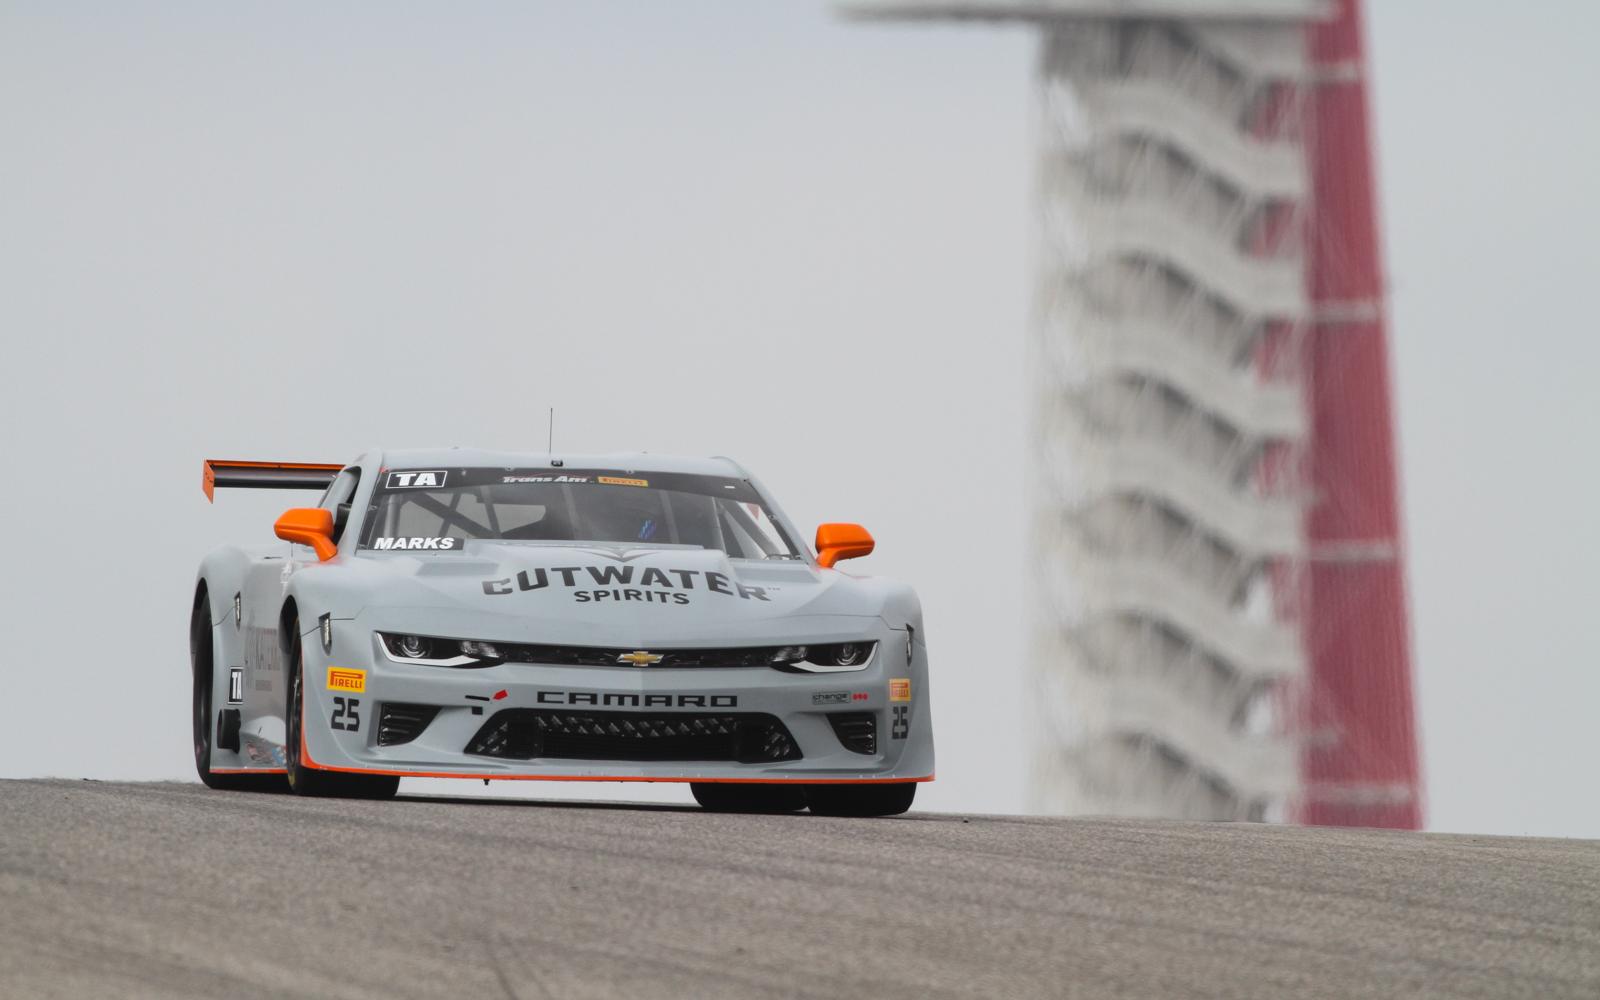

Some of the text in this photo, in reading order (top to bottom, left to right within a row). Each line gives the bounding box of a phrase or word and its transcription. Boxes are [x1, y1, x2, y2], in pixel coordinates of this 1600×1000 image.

[396, 472, 437, 487] TA
[553, 475, 588, 483] Am
[374, 537, 455, 550] MARKS
[481, 565, 772, 602] CUTWATER
[573, 589, 691, 605] SPIRITS
[231, 671, 242, 700] TA
[329, 671, 364, 689] PIRELLI
[536, 691, 738, 708] CAMARO
[330, 696, 360, 732] 25
[891, 706, 909, 740] 25
